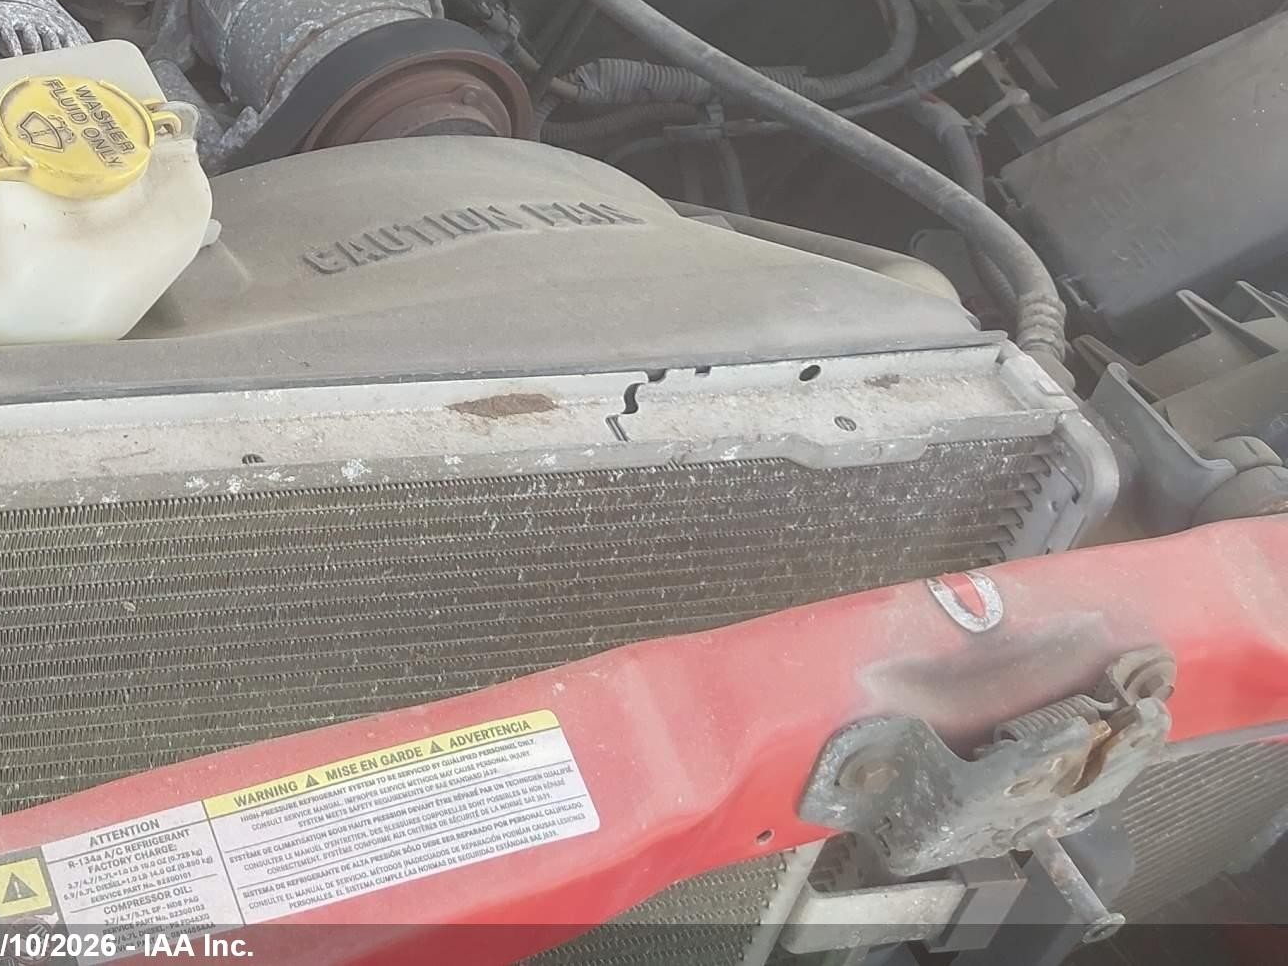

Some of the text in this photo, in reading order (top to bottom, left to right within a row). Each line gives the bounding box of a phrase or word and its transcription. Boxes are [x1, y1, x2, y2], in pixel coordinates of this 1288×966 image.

[43, 78, 126, 169] FLUID ONLY
[75, 85, 136, 155] WASHER
[301, 202, 649, 275] CAUTION FAN
[232, 717, 532, 808] WARNING MISE EN GARDE ADVERTENCIA
[67, 828, 190, 869] R-134a A/C REFRIGERANT
[87, 817, 160, 847] ATTENTION
[87, 842, 177, 874] FACTORY CHARGE:
[102, 883, 192, 915] COMPRESSOR OIL:
